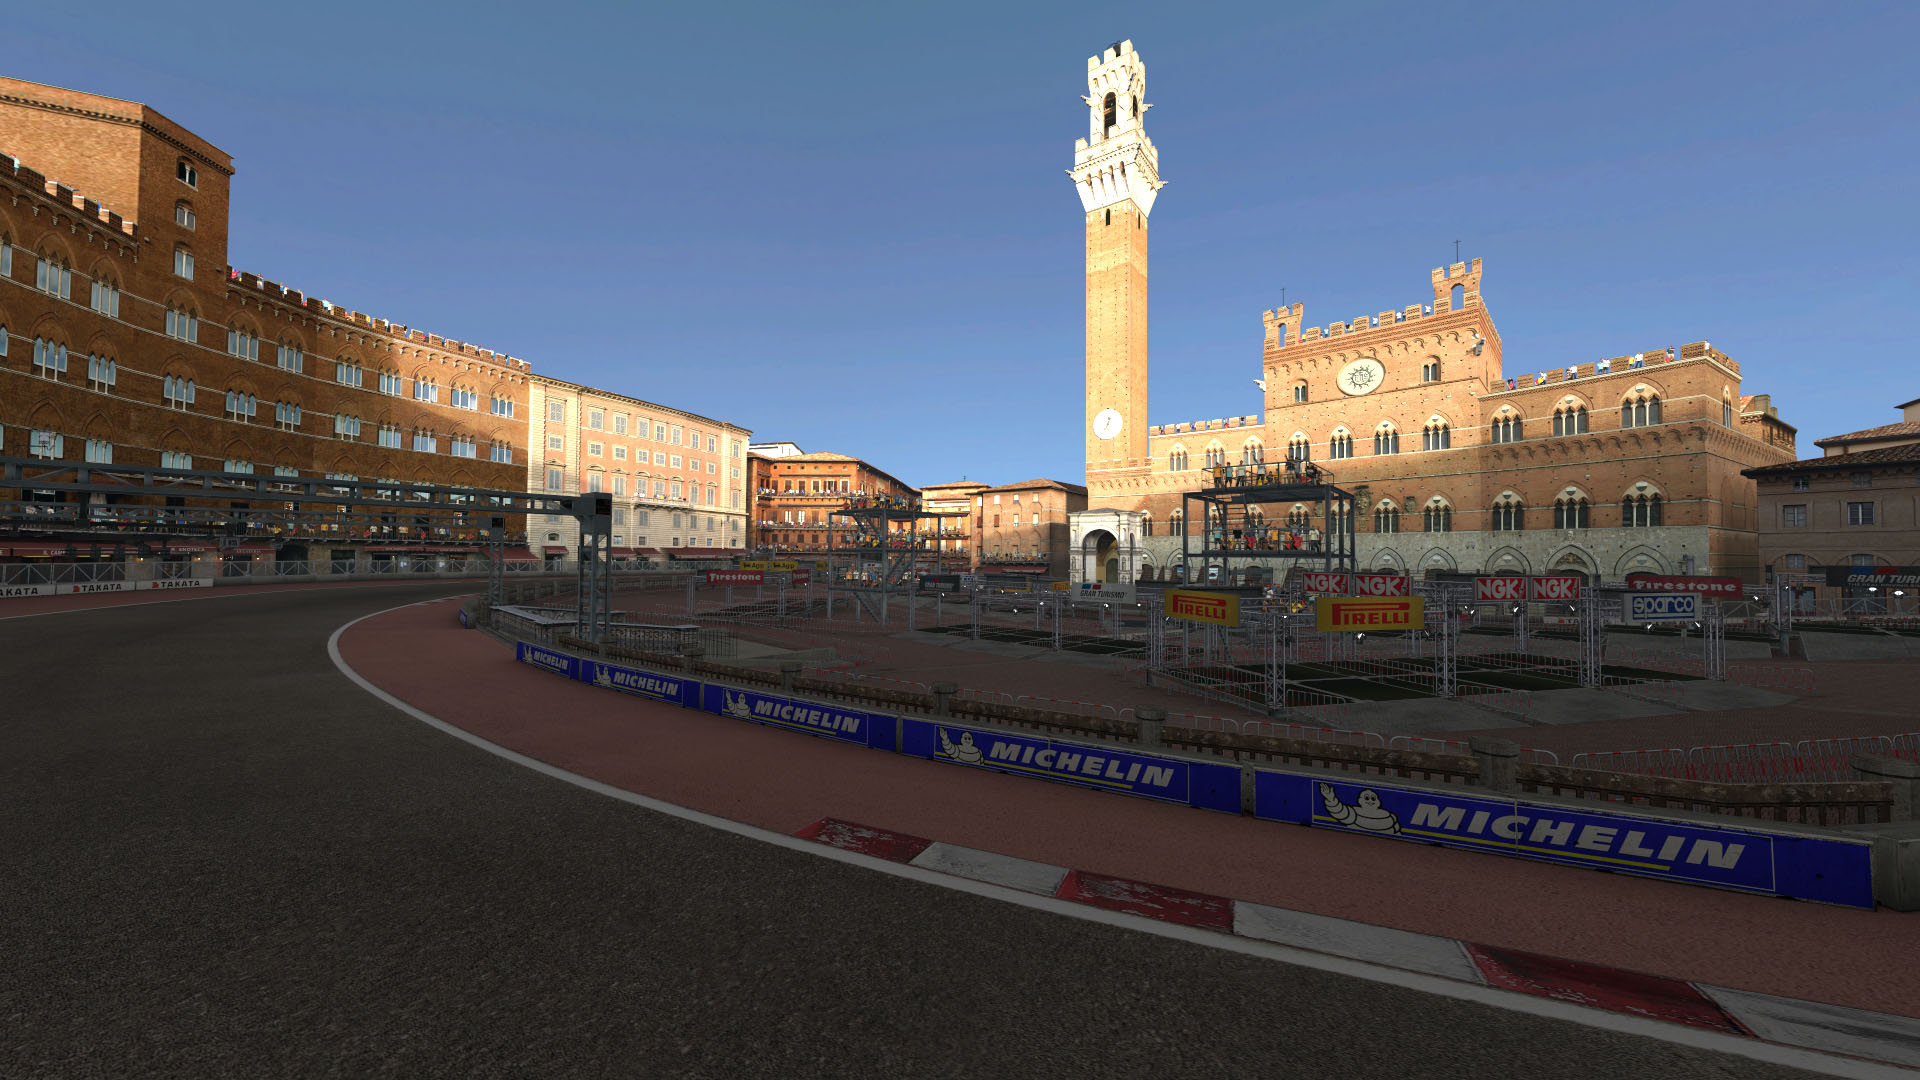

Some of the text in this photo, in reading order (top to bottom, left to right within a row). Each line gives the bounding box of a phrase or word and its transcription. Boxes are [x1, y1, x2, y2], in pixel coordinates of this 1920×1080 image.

[82, 583, 122, 592] TAKATA
[161, 580, 200, 588] TAKATA
[709, 573, 761, 582] Firestone
[1303, 574, 1341, 593] NGK
[1355, 576, 1401, 596] NGK
[1633, 580, 1737, 592] Firestone
[1848, 574, 1886, 583] GRAN
[1097, 591, 1125, 599] TURISMO
[1477, 579, 1519, 599] NGK
[1533, 579, 1572, 599] NGK
[1173, 594, 1226, 620] PIRELLI
[1332, 602, 1410, 625] PIRELLI
[1633, 597, 1694, 618] sparco
[533, 650, 568, 671] MICHELIN
[613, 671, 679, 696] MICHELIN
[754, 700, 861, 734] MICHELIN
[989, 741, 1175, 792] MICHELIN
[1409, 803, 1747, 870] MICHELIN
